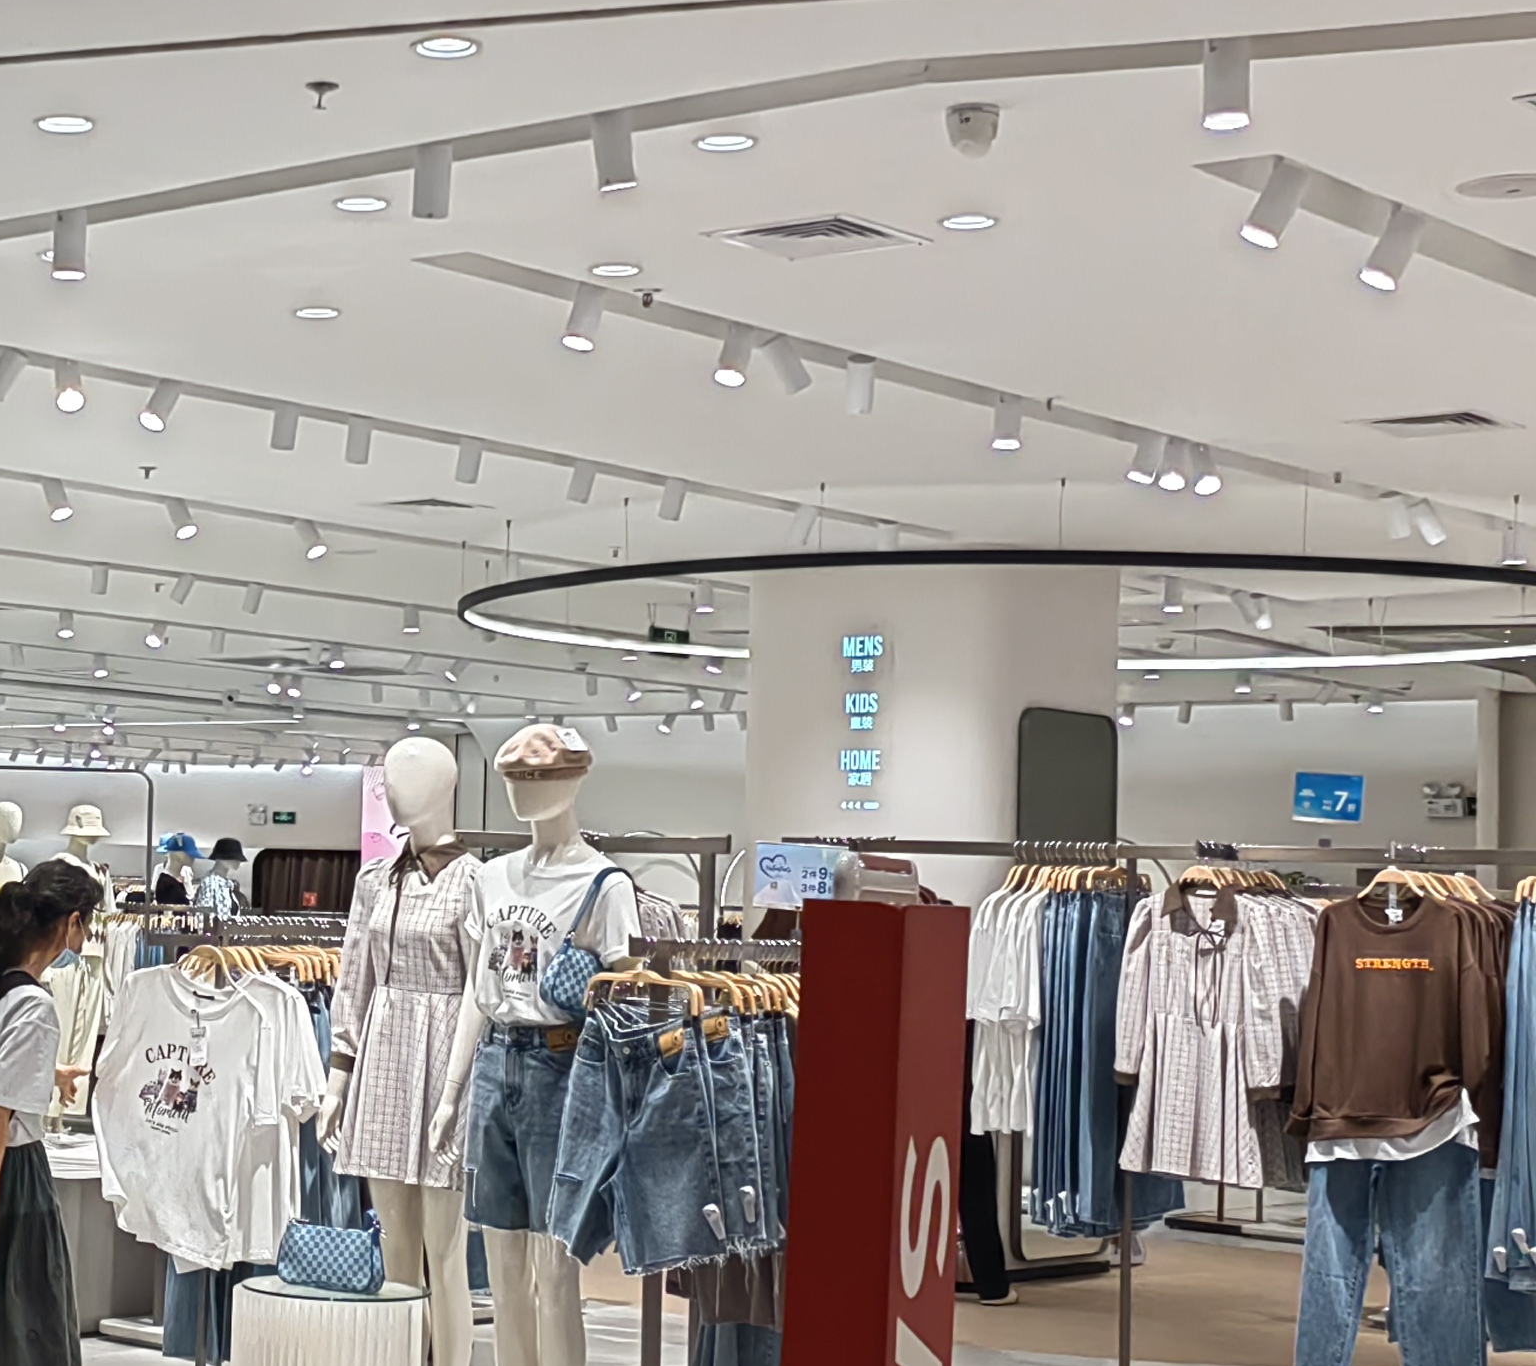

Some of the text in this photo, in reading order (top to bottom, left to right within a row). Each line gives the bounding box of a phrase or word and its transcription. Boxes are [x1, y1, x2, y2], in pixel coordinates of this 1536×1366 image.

[842, 635, 884, 657] MENS
[845, 693, 879, 714] KIDS
[839, 750, 882, 771] HOME
[486, 905, 558, 940] CAPTURE
[145, 1043, 217, 1085] CAPTRE
